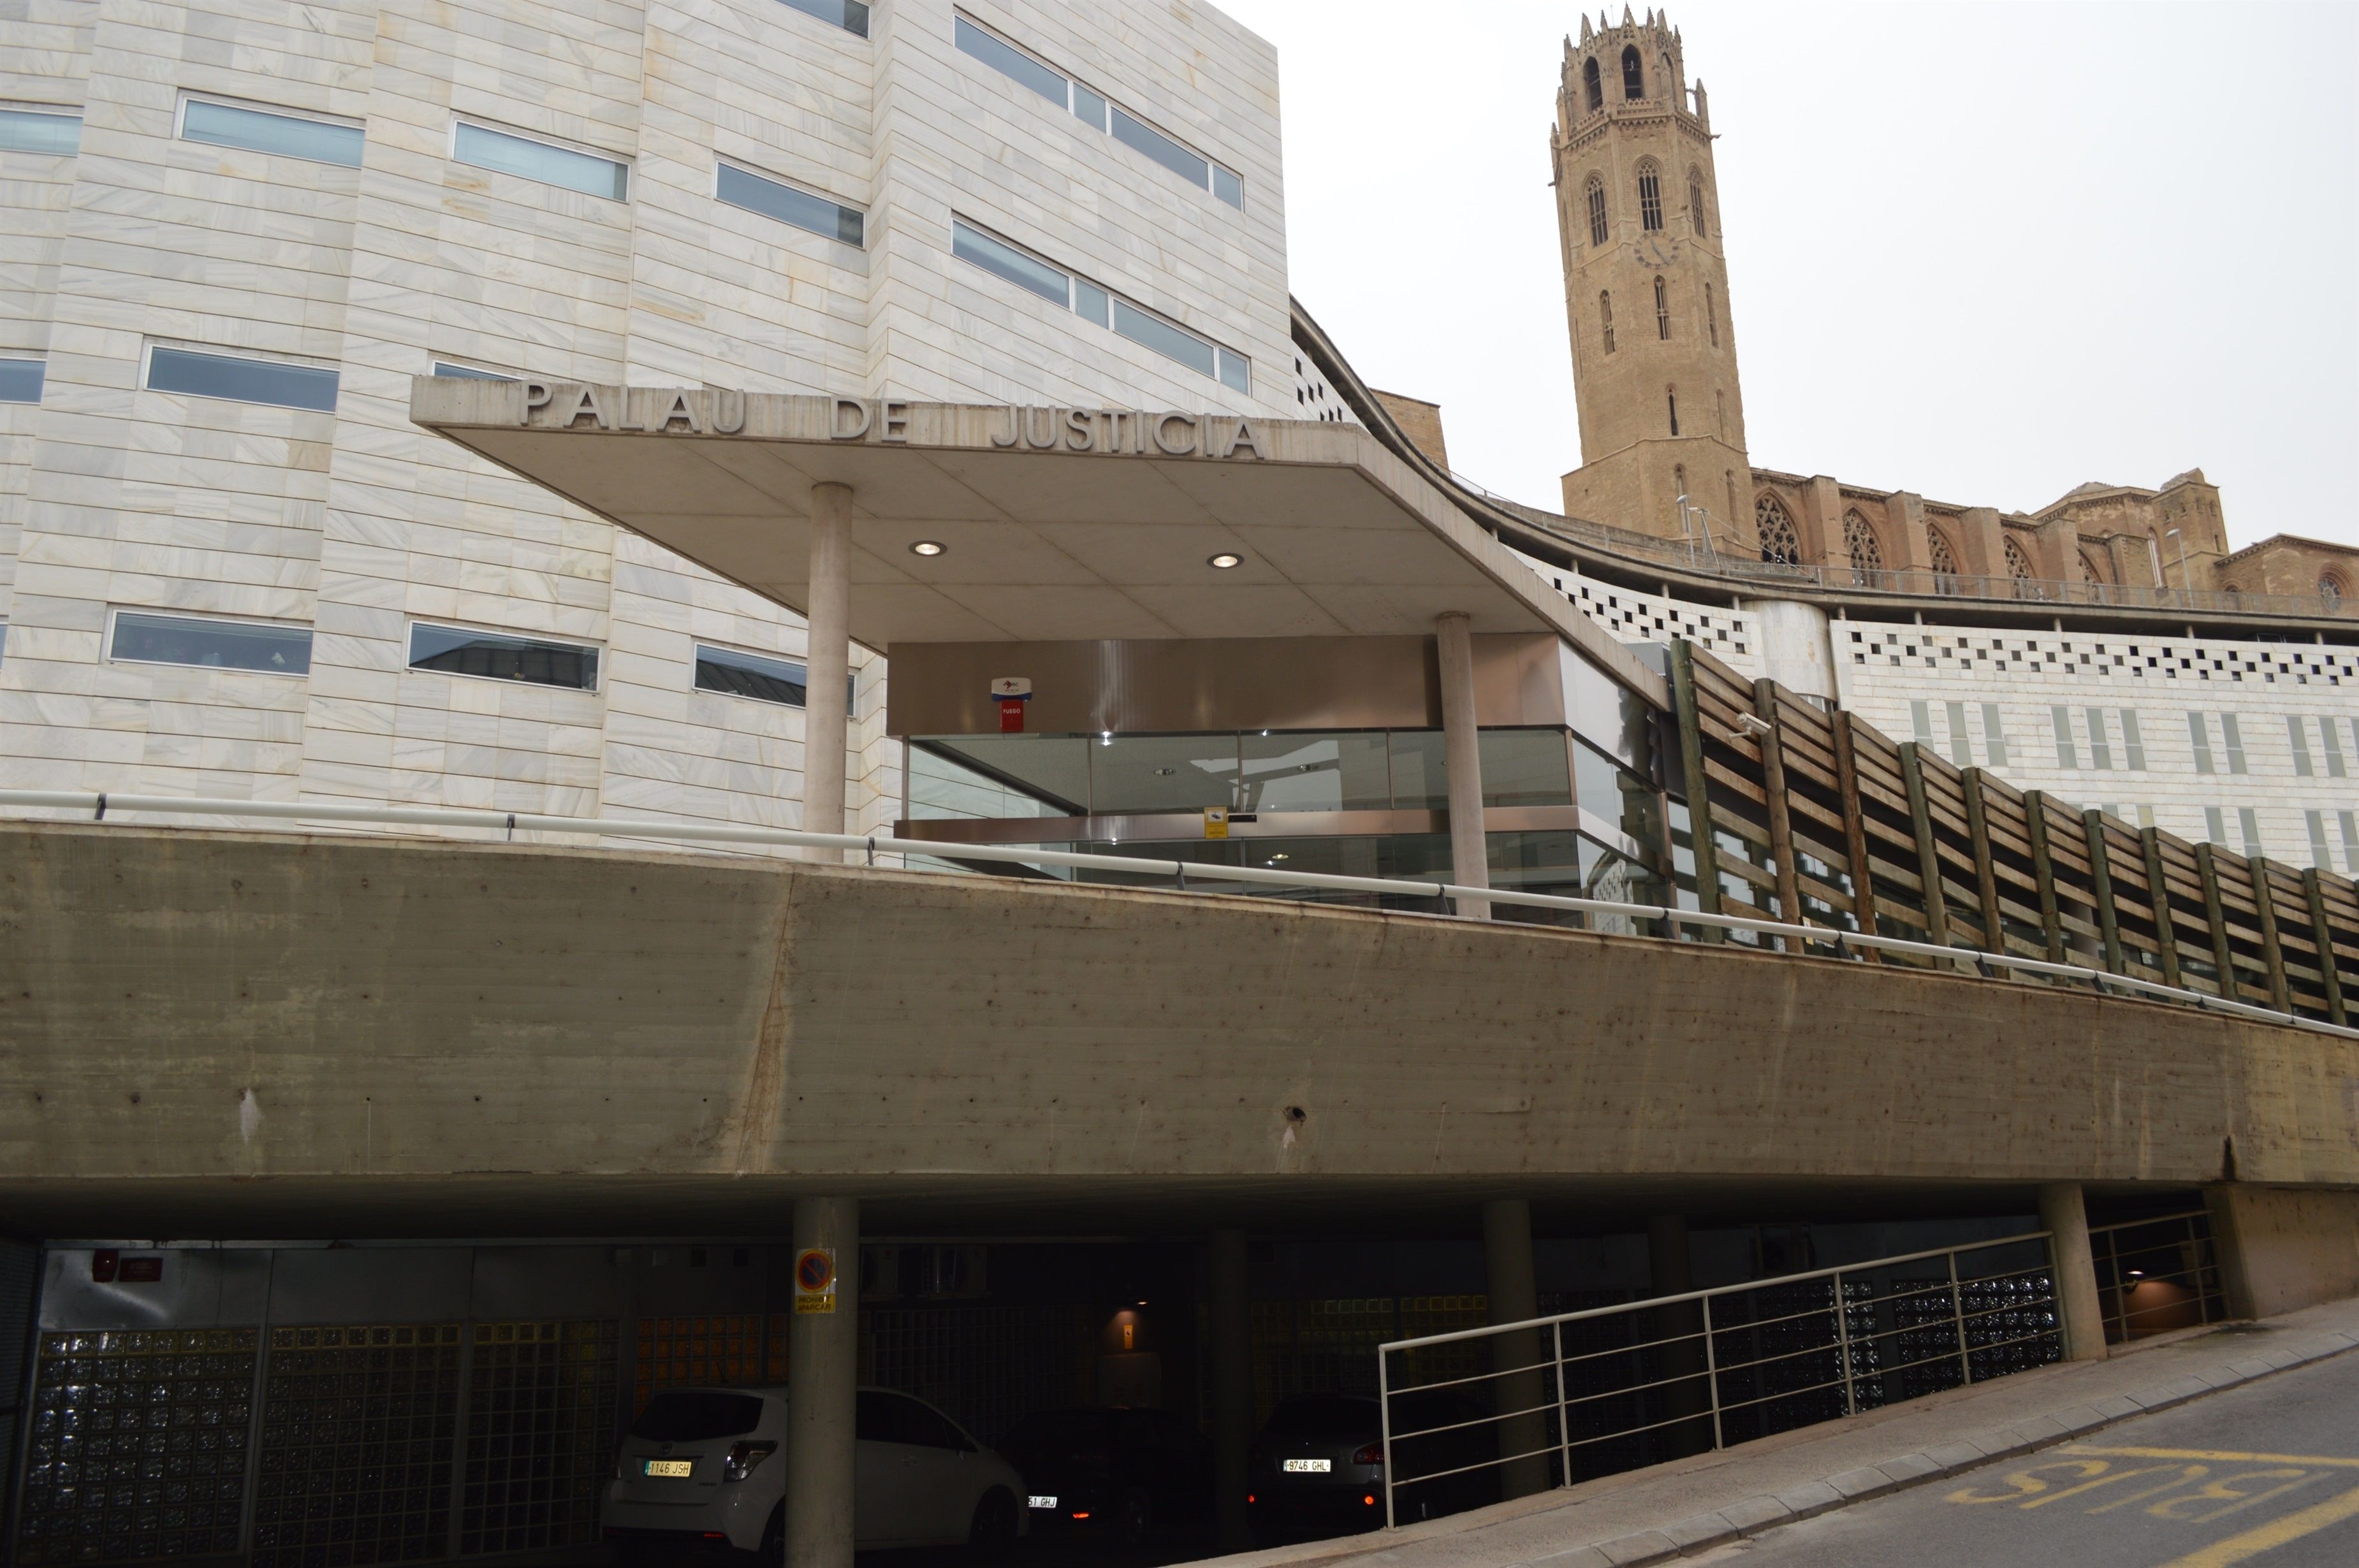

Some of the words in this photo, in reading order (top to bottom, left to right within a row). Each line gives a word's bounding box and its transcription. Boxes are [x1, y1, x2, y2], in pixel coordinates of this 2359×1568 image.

[520, 379, 745, 435] PALAU
[830, 395, 907, 444] DE
[991, 403, 1266, 460] JUSTICIA
[650, 1463, 670, 1474] 1146
[672, 1463, 689, 1474] JSH
[1289, 1460, 1308, 1470] 9746
[1312, 1461, 1327, 1471] GHL
[1941, 1457, 2335, 1525] BUS
[1041, 1498, 1056, 1507] GHJ
